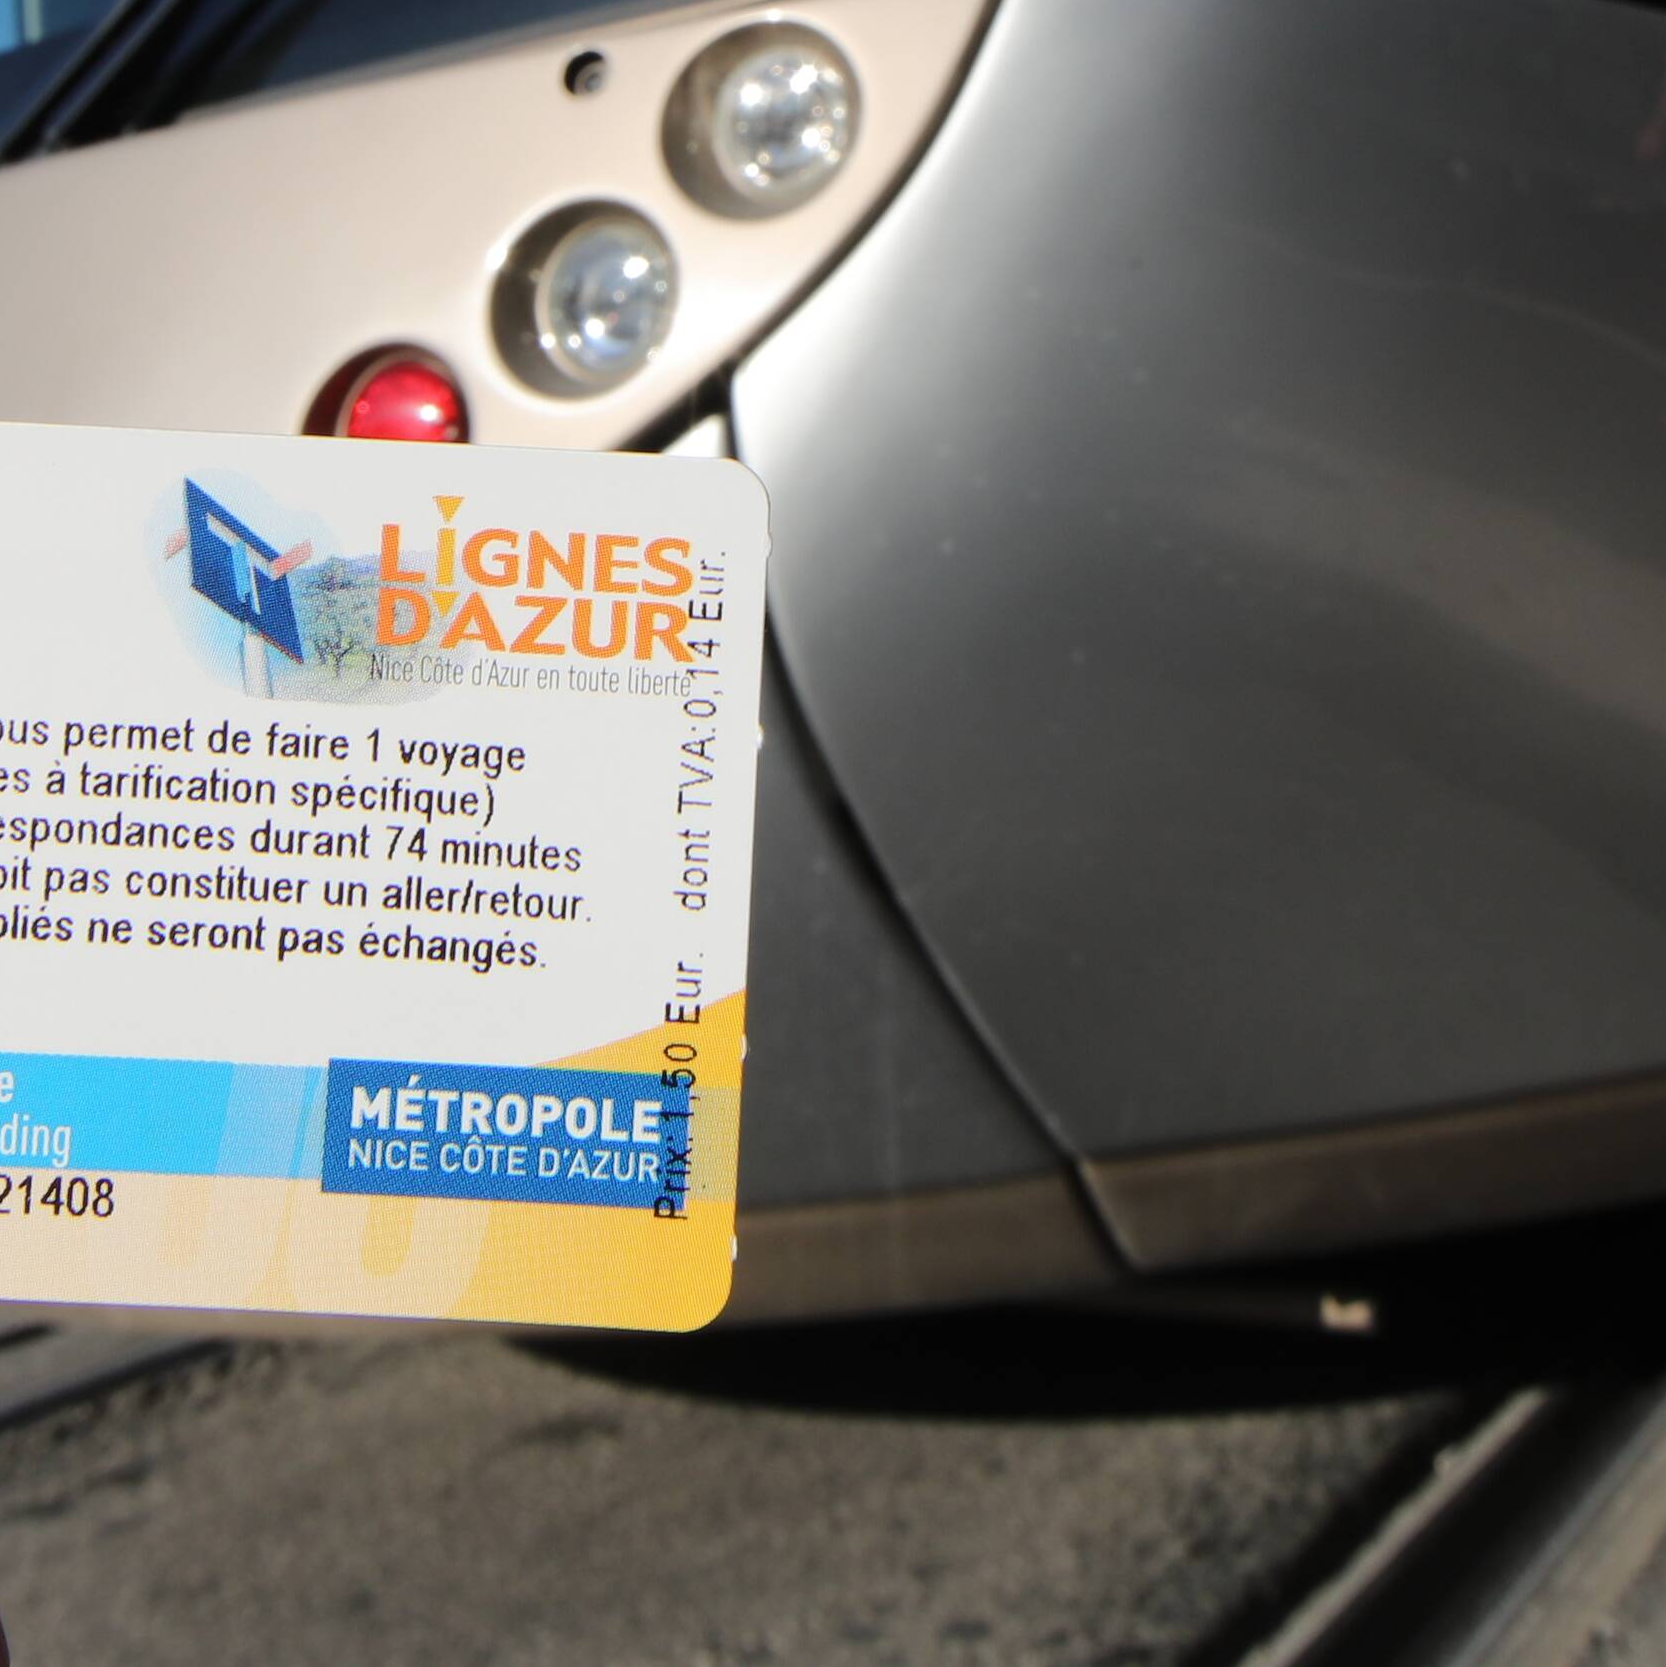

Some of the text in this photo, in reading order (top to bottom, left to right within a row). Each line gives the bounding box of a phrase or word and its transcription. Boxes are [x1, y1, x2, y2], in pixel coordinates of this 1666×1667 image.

[381, 495, 693, 596] LIGNES
[689, 551, 726, 621] Eur.
[369, 654, 692, 696] Nice Côte d'Azur en toute liberté
[64, 719, 194, 756] permet
[208, 720, 251, 754] de
[267, 723, 349, 760] faire
[368, 729, 379, 762] 1
[399, 740, 525, 782] voyage
[46, 761, 65, 794] à
[81, 762, 275, 804] tarification
[292, 775, 494, 827] spécifique)
[251, 819, 370, 858] durant
[387, 826, 427, 861] 74
[442, 832, 581, 871] minutes
[673, 829, 711, 911] dont
[44, 868, 109, 901] pas
[126, 866, 308, 903] constituer
[324, 881, 367, 907] un
[383, 876, 590, 921] aller/retour.
[88, 919, 132, 944] ne
[148, 917, 266, 950] seront
[278, 927, 344, 961] pas
[359, 922, 545, 974] échangés.
[665, 952, 703, 1024] Eur.
[350, 1074, 663, 1143] MÉTROPOLE
[348, 1137, 660, 1183] NICE CÔTE D'AZUR
